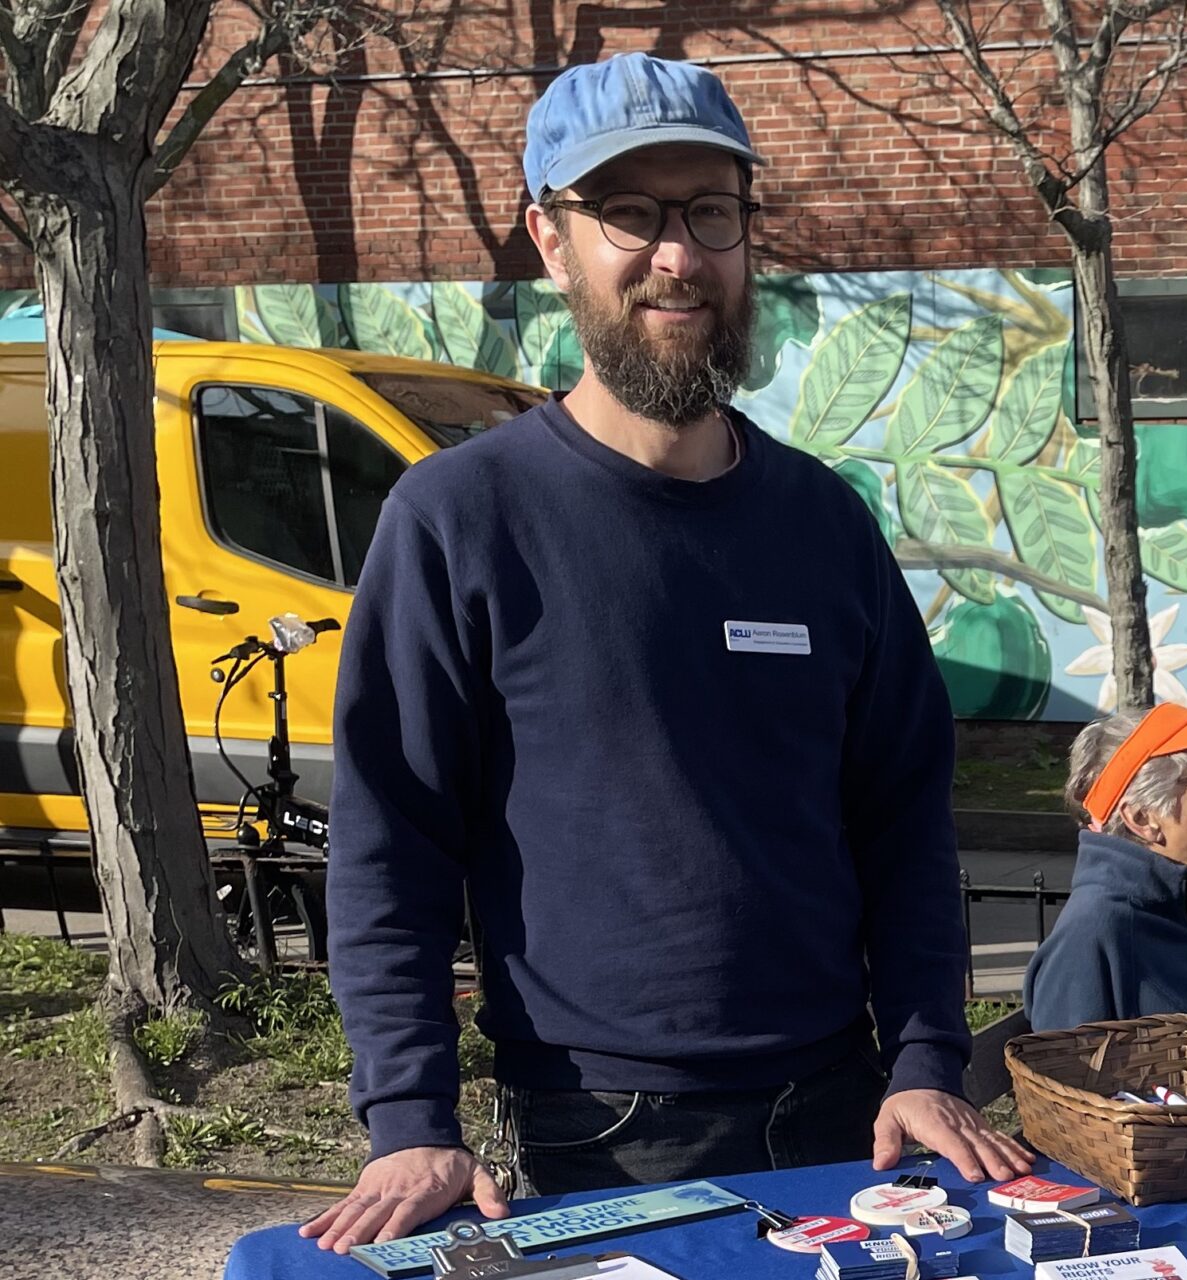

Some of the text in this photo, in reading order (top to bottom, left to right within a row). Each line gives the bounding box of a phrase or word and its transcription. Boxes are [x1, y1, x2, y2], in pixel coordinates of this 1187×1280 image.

[729, 628, 751, 638] ACLU
[362, 1243, 401, 1255] WE
[583, 1199, 647, 1214] DARE
[377, 1250, 406, 1260] TO
[537, 1209, 629, 1232] MORE
[541, 1213, 648, 1239] UNION
[1056, 1257, 1141, 1272] KNOW YOUR
[1061, 1268, 1114, 1279] RIGHTS
